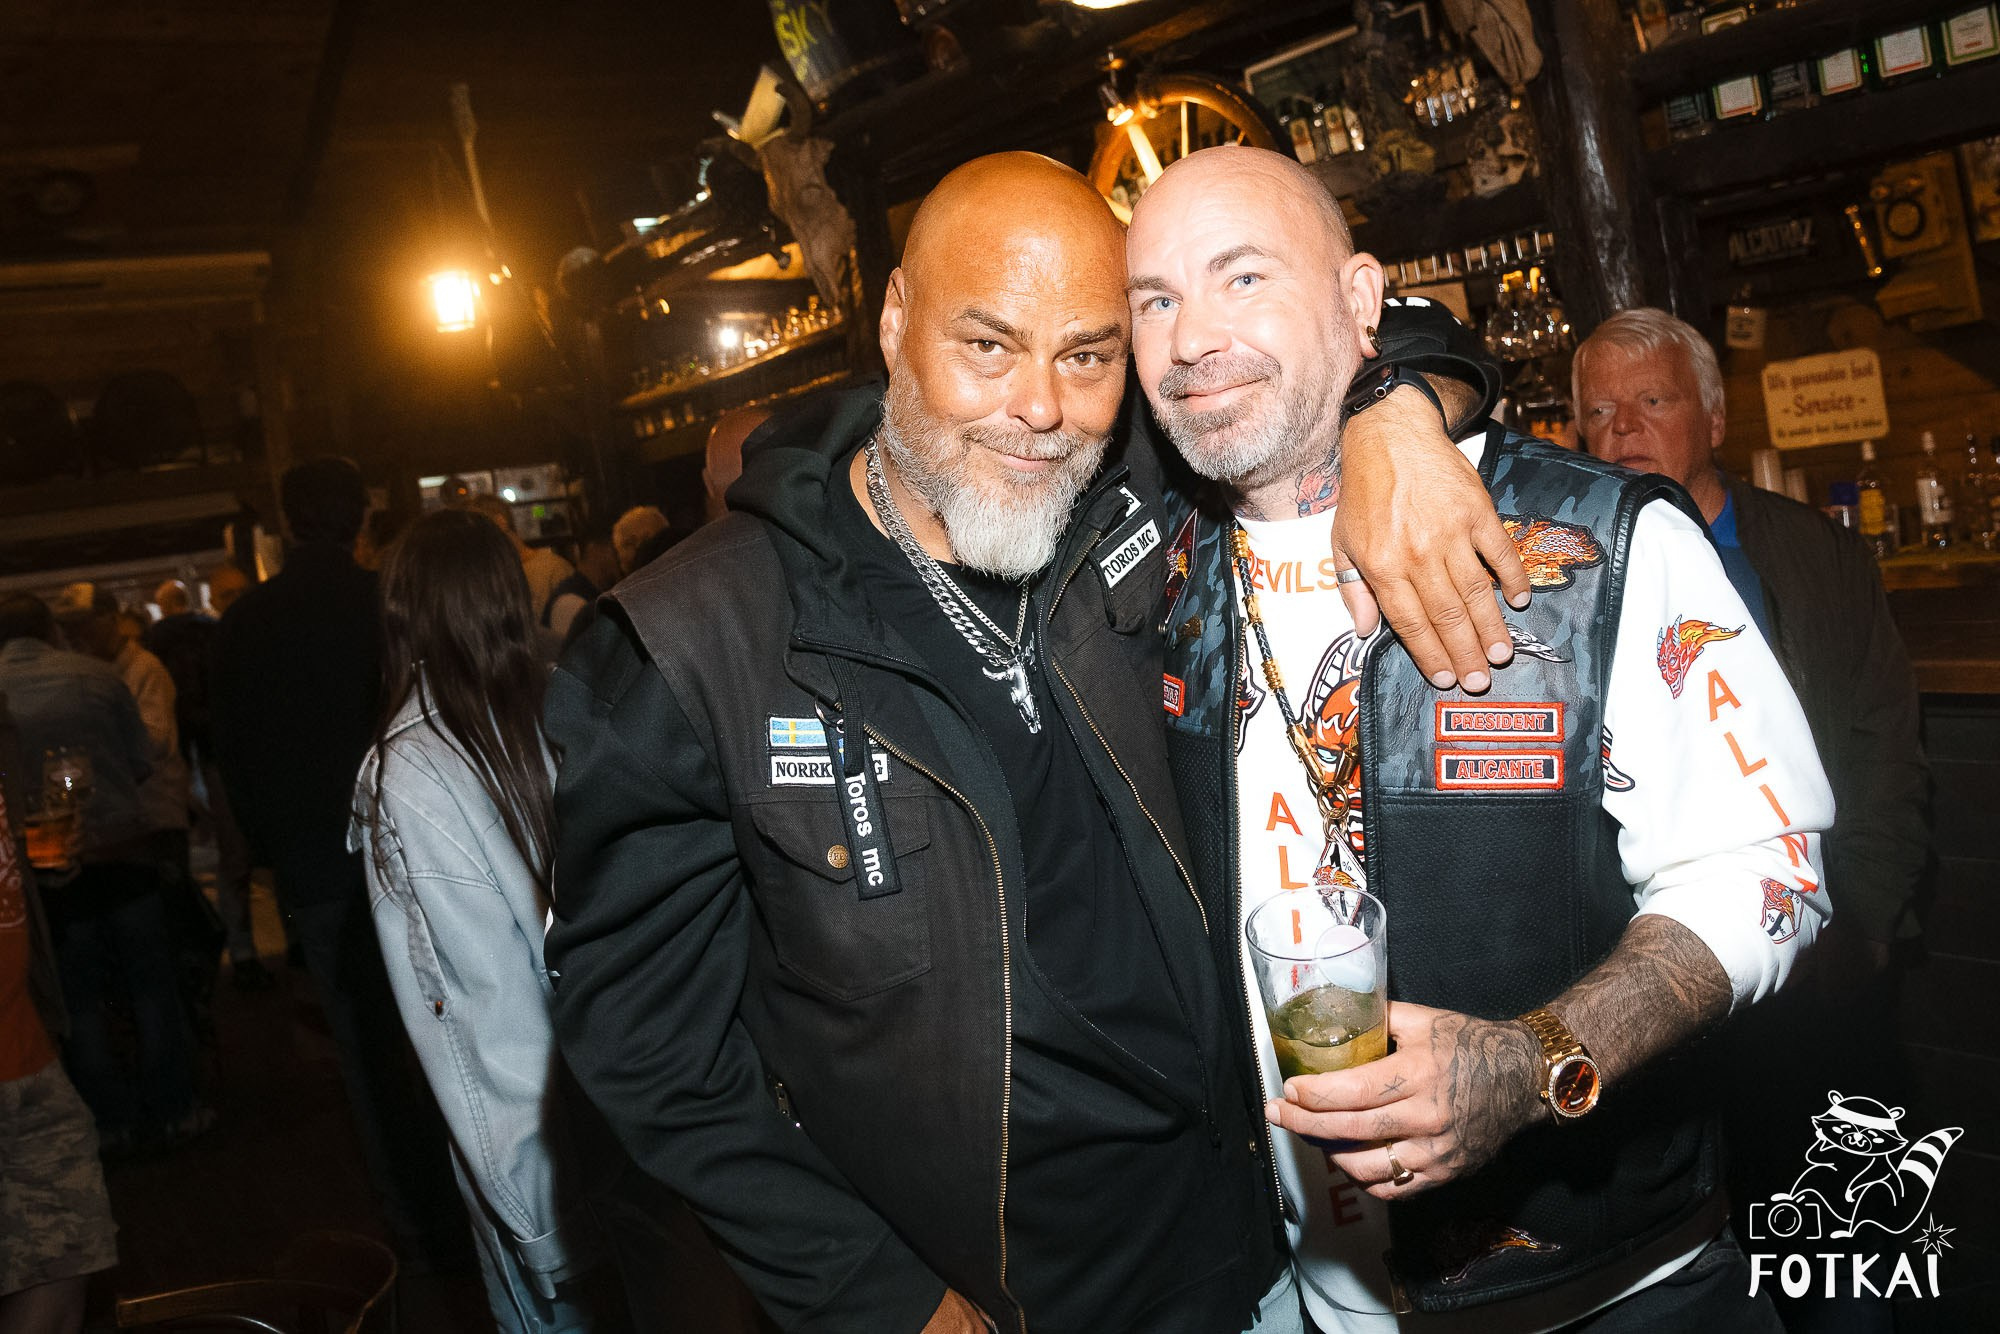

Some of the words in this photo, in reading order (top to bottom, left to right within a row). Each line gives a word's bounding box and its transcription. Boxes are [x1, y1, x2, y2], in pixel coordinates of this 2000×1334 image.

[1728, 218, 1812, 261] ALCATRAZ
[1793, 394, 1854, 418] Service
[1102, 542, 1140, 580] TOROS
[1136, 528, 1155, 551] MC
[1450, 712, 1548, 731] PRESIDENT
[1455, 759, 1545, 780] ALICANTE
[845, 772, 873, 837] Toros
[862, 848, 884, 887] mc
